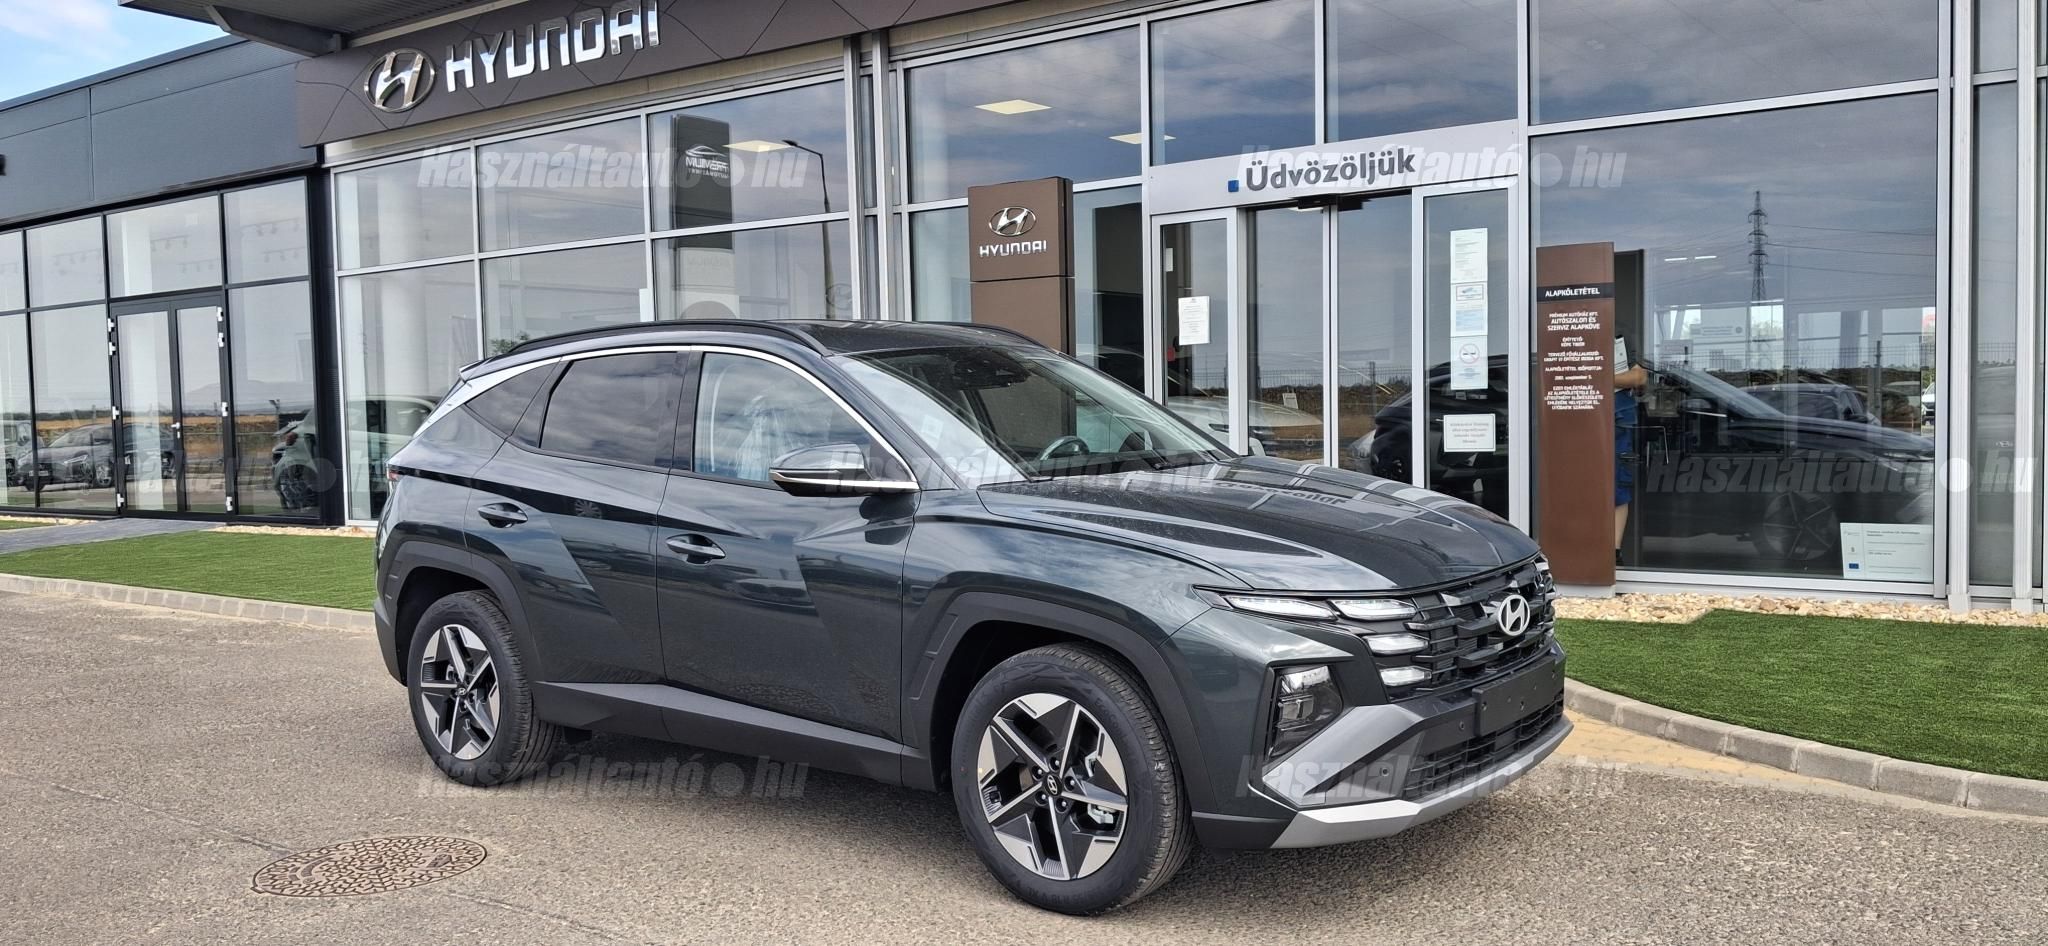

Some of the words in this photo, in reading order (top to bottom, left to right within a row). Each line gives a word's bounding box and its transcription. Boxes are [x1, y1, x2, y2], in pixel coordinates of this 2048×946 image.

[445, 0, 661, 93] HYUNDAI
[1246, 147, 1415, 191] Üdvözöljük
[979, 240, 1047, 257] HYUNDAI
[1545, 286, 1600, 297] ALAPKŐLETÉTEL
[1571, 322, 1600, 330] ALAPKÖVE
